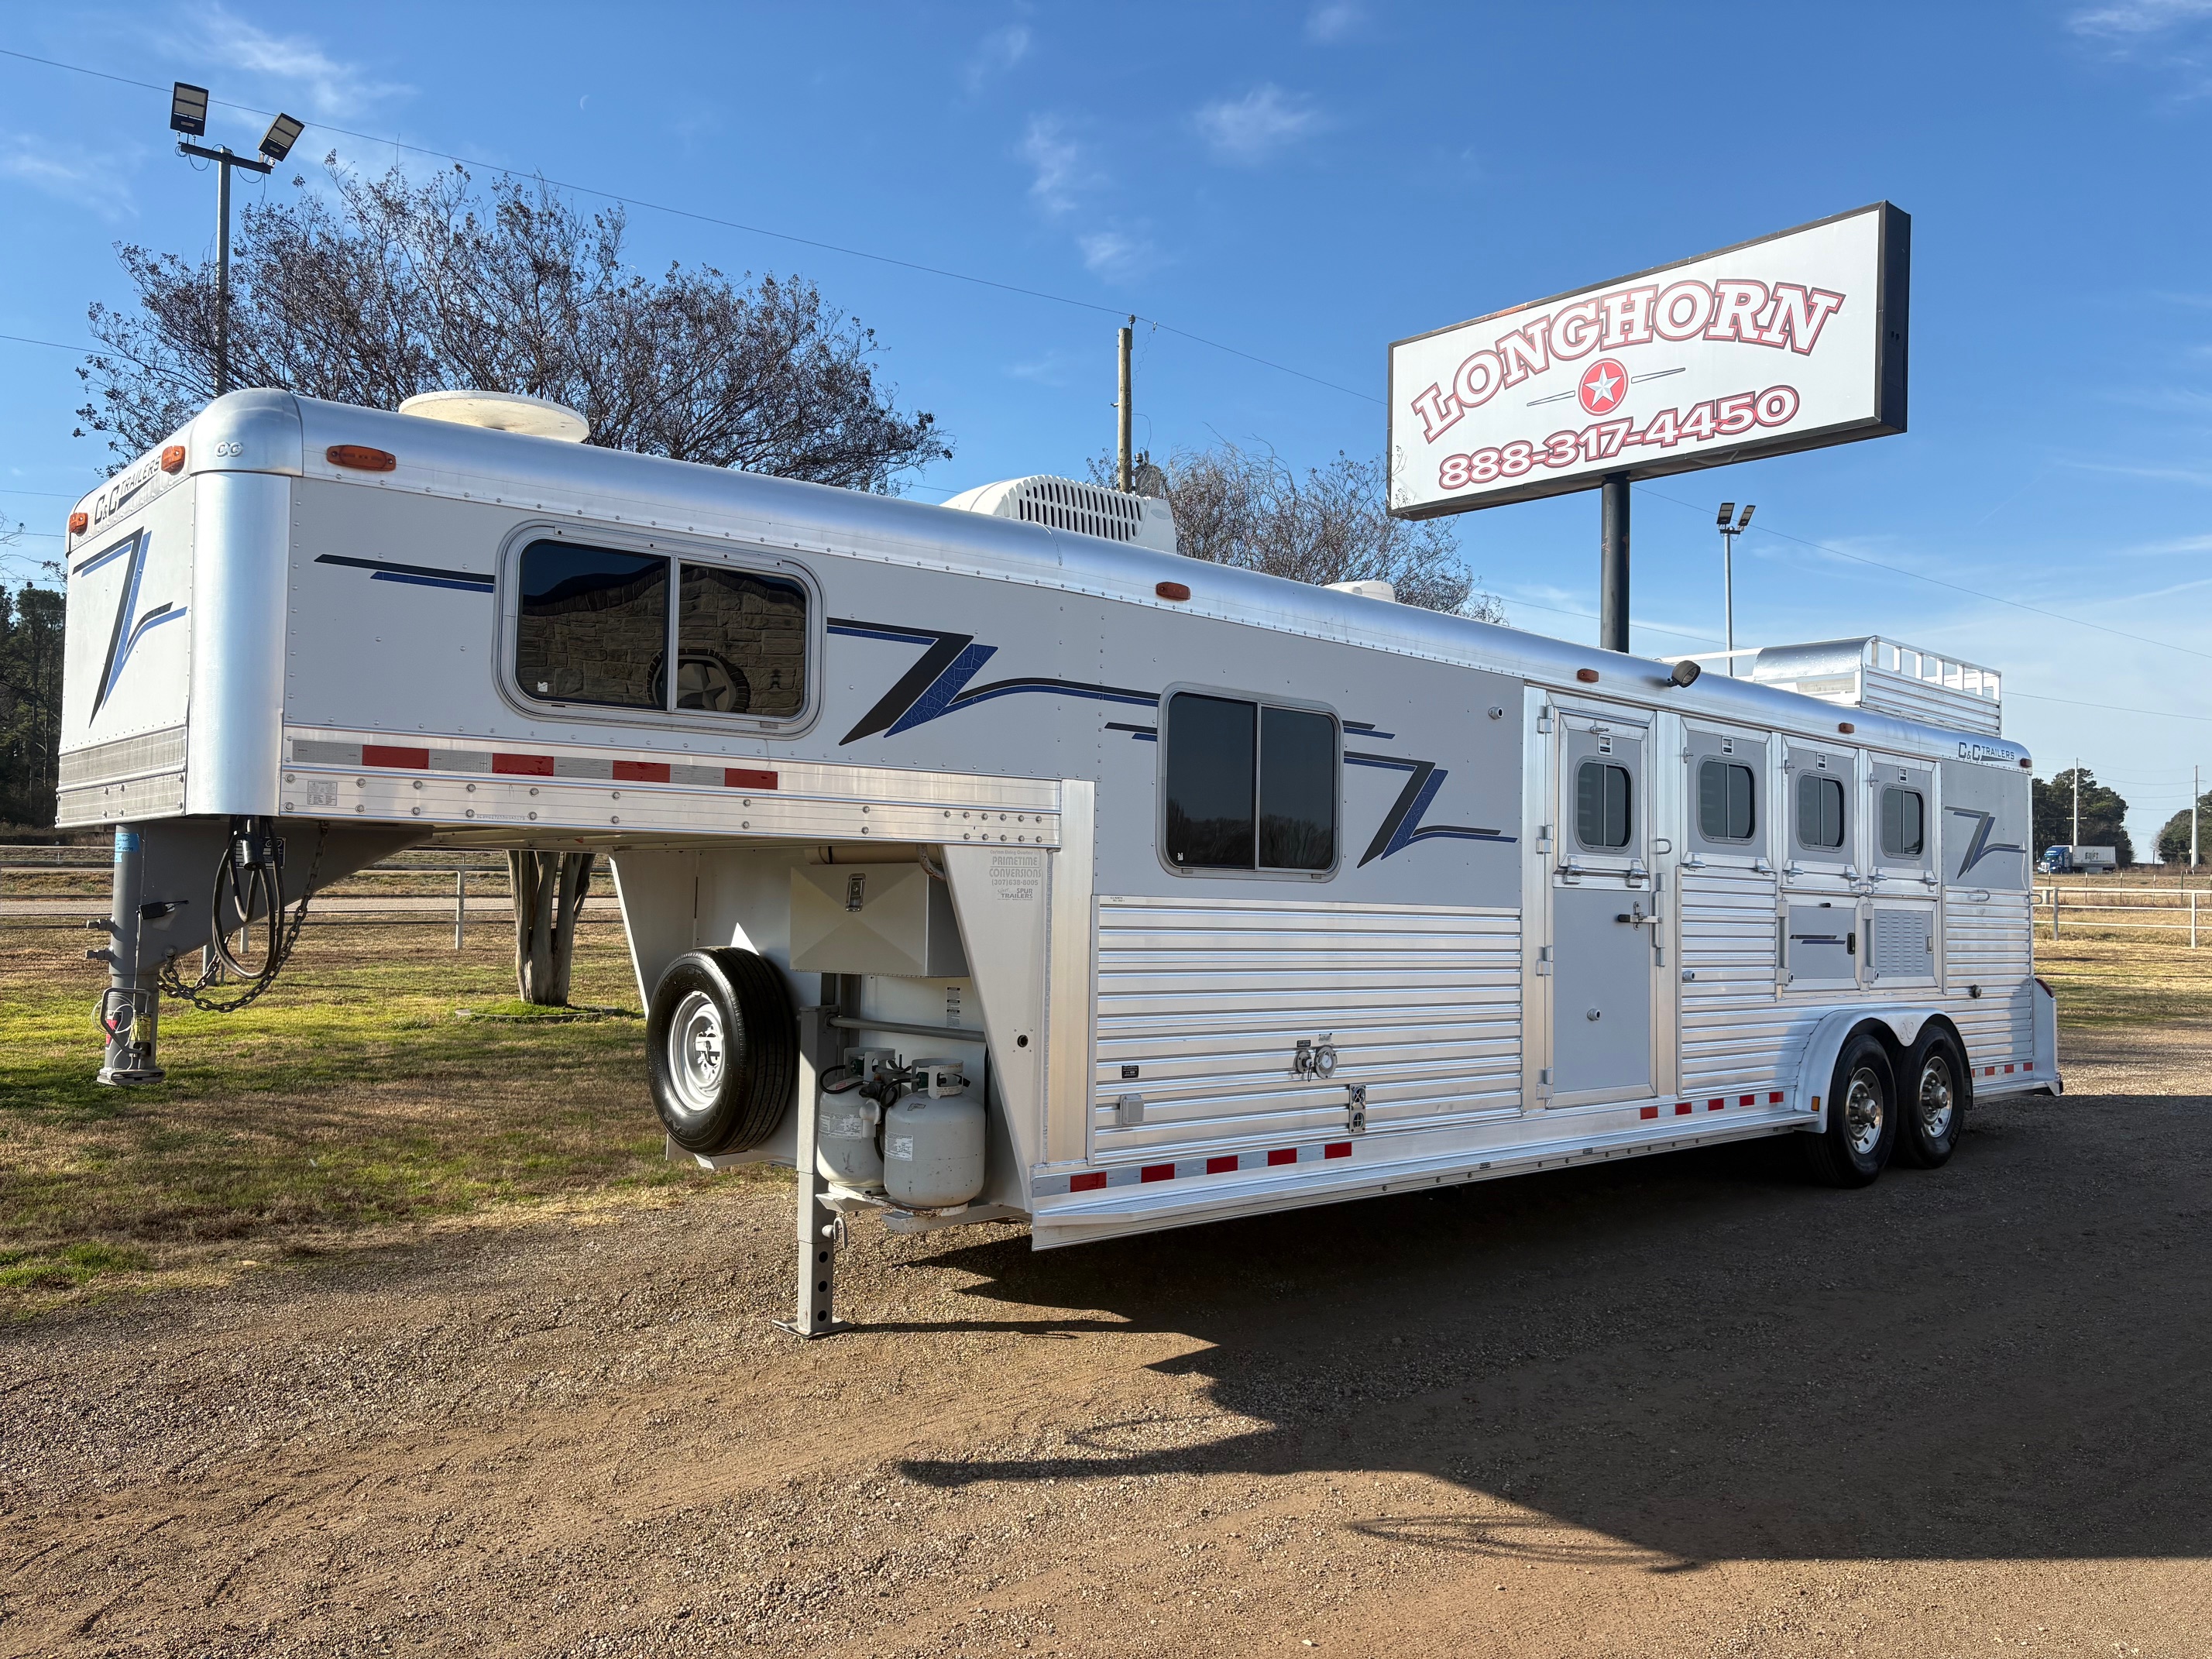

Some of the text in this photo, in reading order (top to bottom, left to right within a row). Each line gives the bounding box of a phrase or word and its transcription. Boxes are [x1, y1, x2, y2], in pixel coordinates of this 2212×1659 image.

[1411, 278, 1846, 445] LONGHORN
[1438, 385, 1801, 490] 888-317-4450
[94, 455, 162, 526] C&C TRAILERS
[1958, 741, 2015, 761] C&C TRAILERS
[989, 868, 1042, 878] CONVERSIONS
[992, 856, 1038, 866] PRIMETIME
